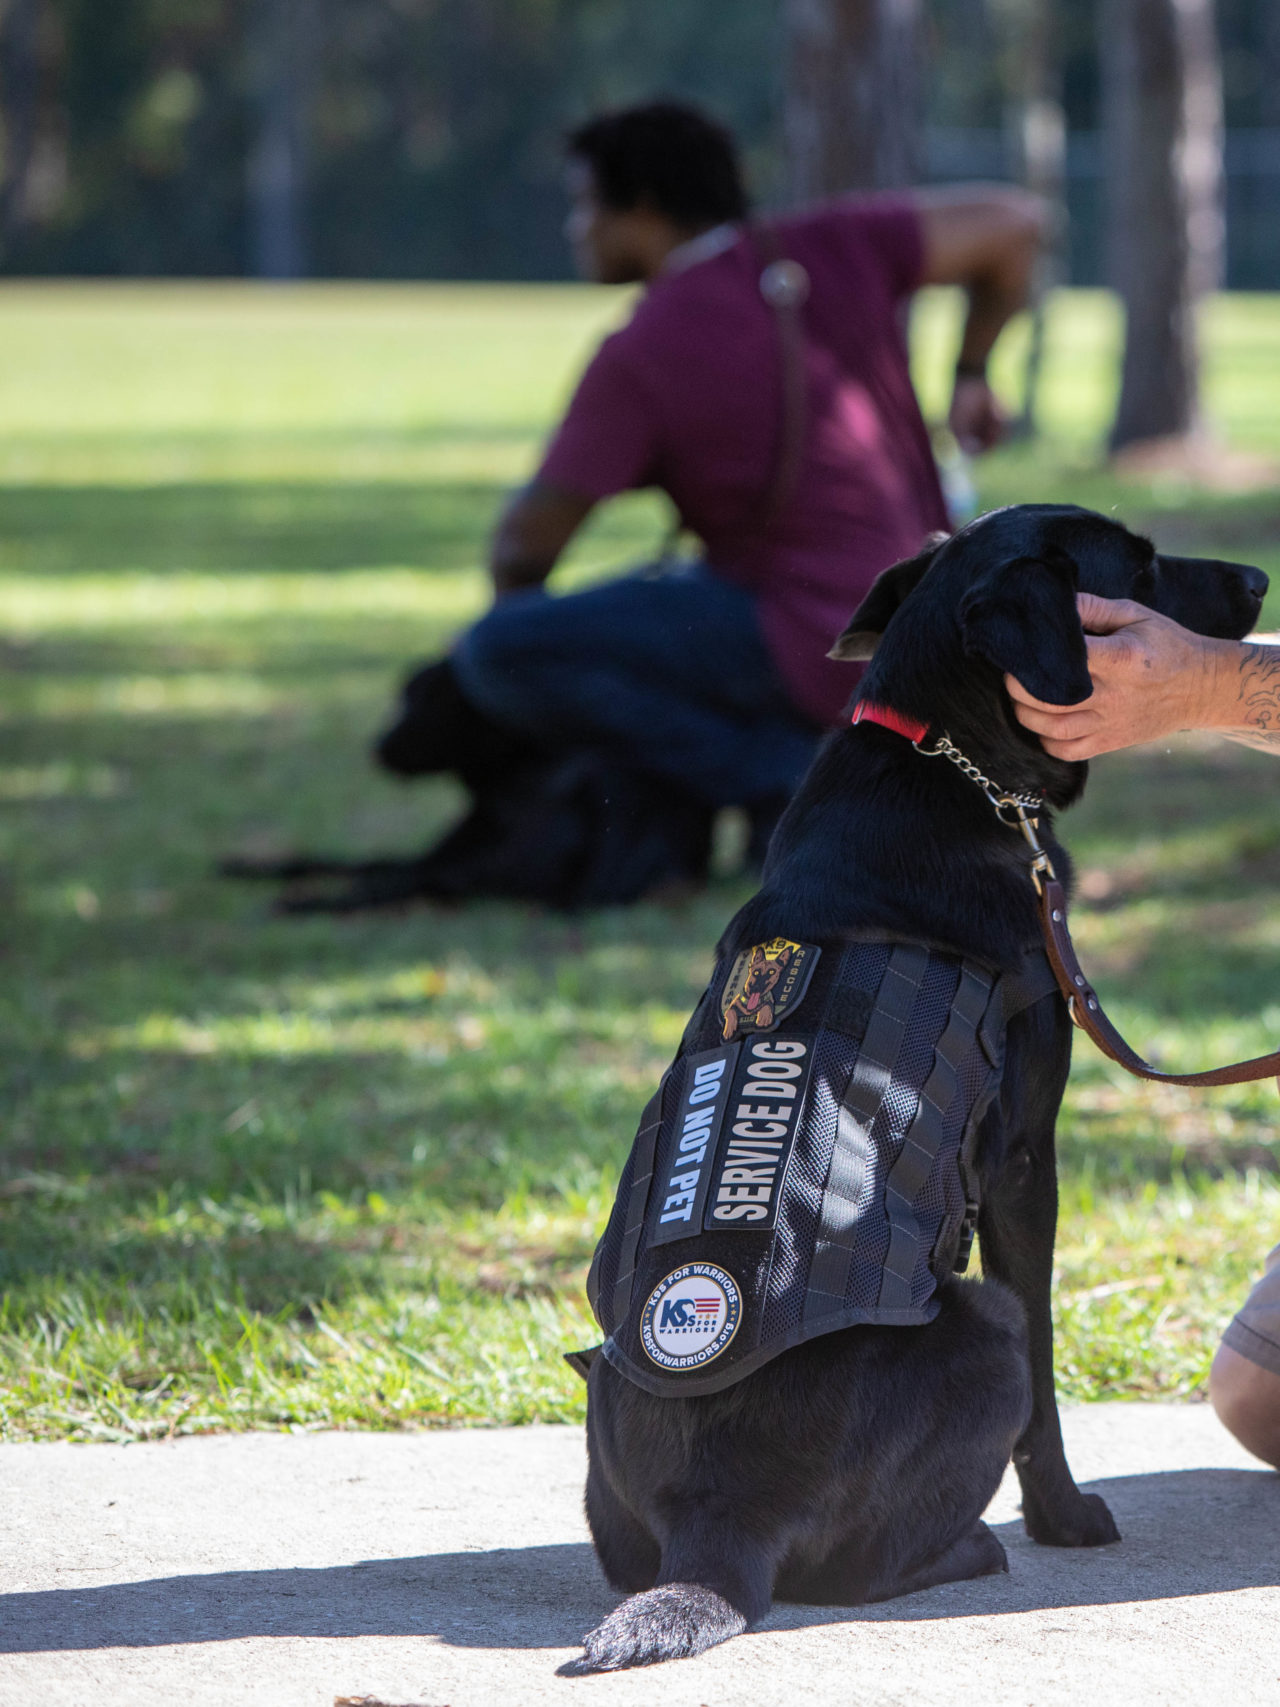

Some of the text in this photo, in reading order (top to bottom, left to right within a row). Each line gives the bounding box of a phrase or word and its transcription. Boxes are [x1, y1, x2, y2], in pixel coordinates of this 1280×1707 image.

[766, 940, 786, 950] K9
[780, 950, 805, 1002] RESCUE
[660, 1060, 726, 1224] DO NOT PET
[713, 1041, 807, 1221] SERVICE DOG
[668, 1267, 690, 1285] FOR
[693, 1265, 738, 1303] WARRIORS
